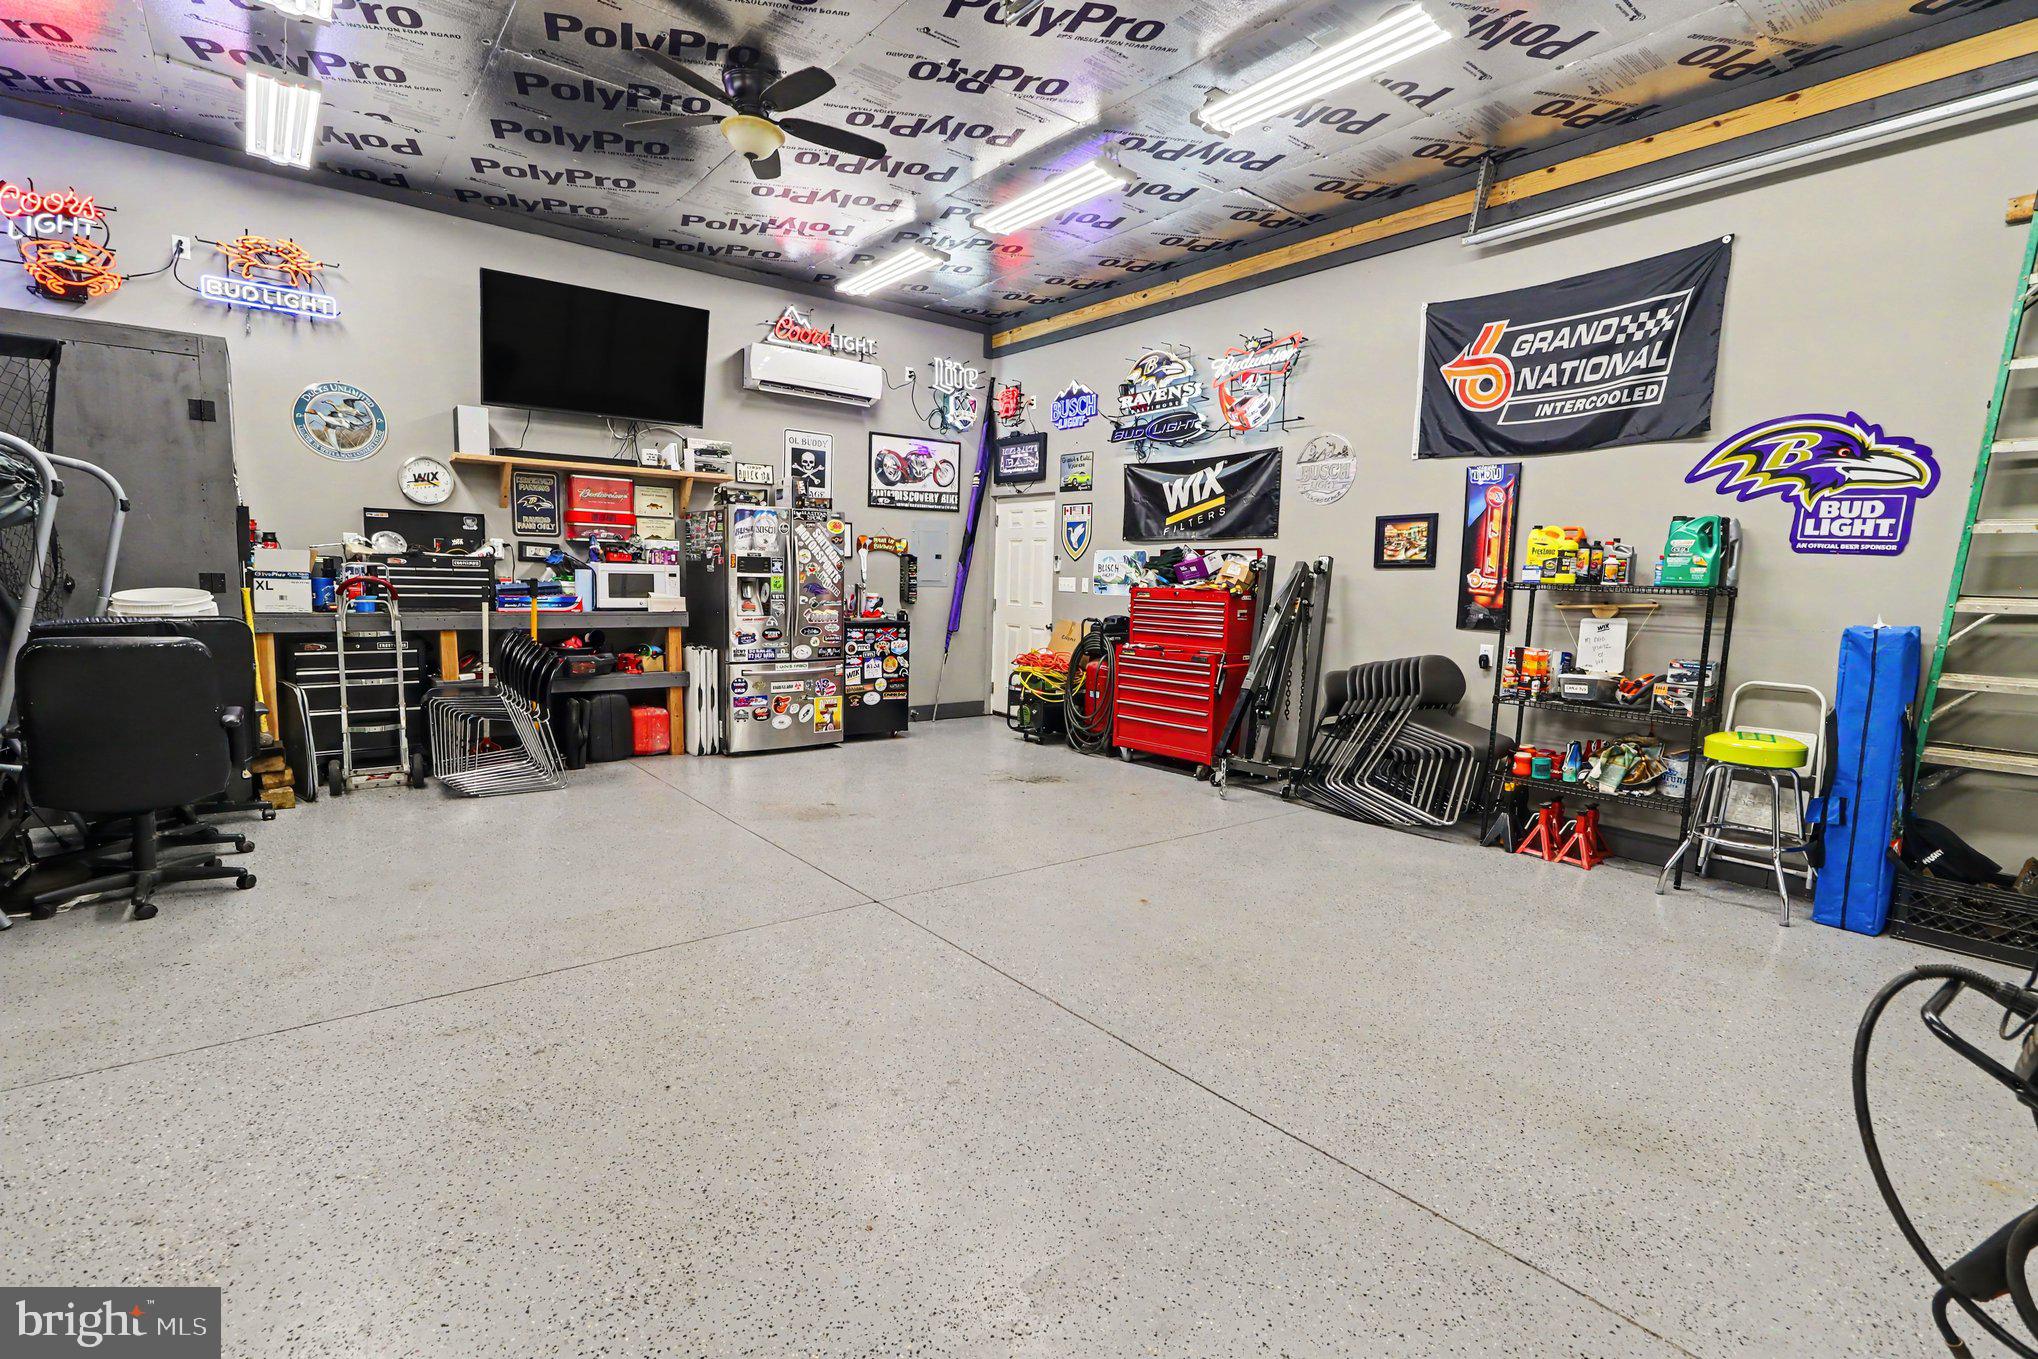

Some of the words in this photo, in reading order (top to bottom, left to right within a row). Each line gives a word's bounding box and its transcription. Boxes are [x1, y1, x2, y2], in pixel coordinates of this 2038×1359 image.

[513, 71, 711, 115] PolyPro
[321, 126, 424, 157] Poly
[490, 118, 670, 156] PolyPro
[846, 111, 1025, 148] PolyPro
[795, 151, 960, 183] PolyPro
[1120, 136, 1287, 172] PolyPro
[470, 157, 637, 190] PolyPro
[454, 189, 608, 216] PolyPro
[751, 186, 903, 213] PolyPro
[8, 213, 98, 240] LIGHT
[652, 238, 782, 260] PolyPro
[206, 278, 258, 300] BUD
[262, 284, 334, 315] LIGHT
[774, 316, 831, 347] Coors
[830, 333, 876, 354] LIGHT
[1511, 316, 1622, 358] GRAND
[933, 357, 979, 394] Lite
[1516, 340, 1668, 391] NATIONAL
[1051, 393, 1097, 421] BUSCH
[1118, 381, 1196, 409] RAVENS
[1534, 384, 1659, 418] INTERCOOLED
[1058, 415, 1086, 429] LIGHT
[1114, 428, 1145, 440] BUD
[1152, 419, 1197, 435] LIGHT
[801, 438, 829, 448] BUDDY
[412, 471, 440, 483] WIX
[1161, 459, 1227, 513] WIX
[894, 490, 939, 504] DISCOVERY
[1819, 500, 1886, 519] BUD
[1163, 507, 1226, 536] FILTERS
[1097, 563, 1120, 573] BUSCH
[254, 579, 274, 591] XL
